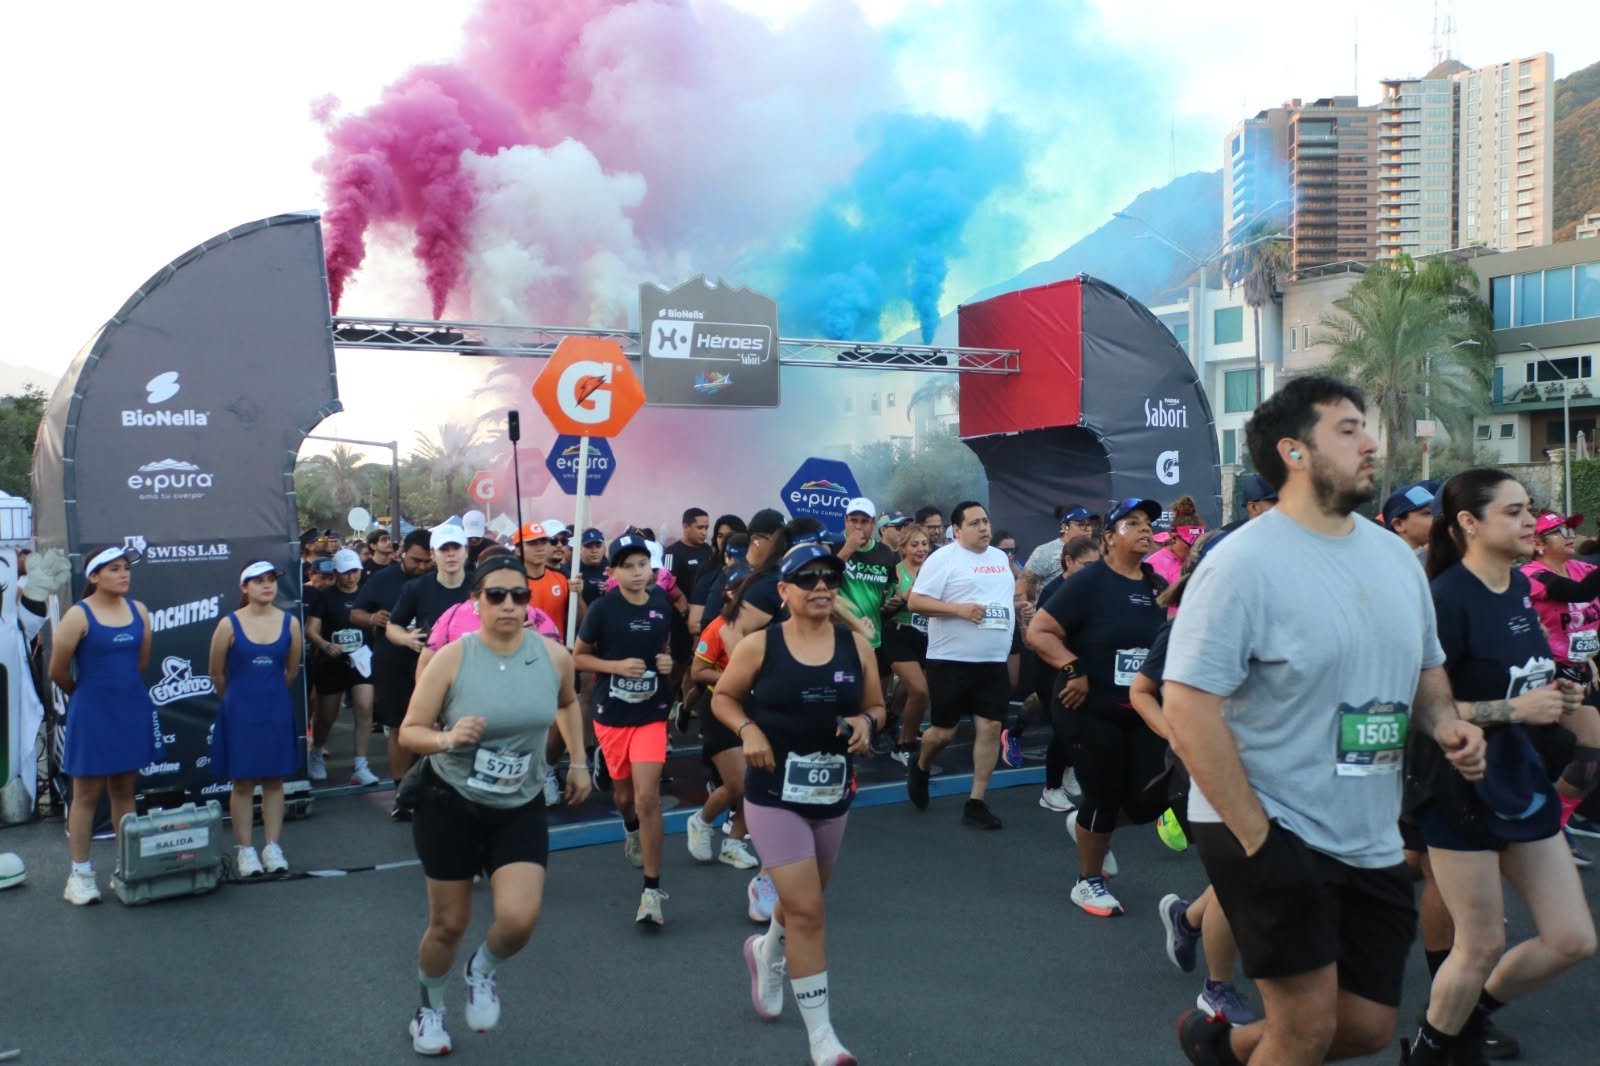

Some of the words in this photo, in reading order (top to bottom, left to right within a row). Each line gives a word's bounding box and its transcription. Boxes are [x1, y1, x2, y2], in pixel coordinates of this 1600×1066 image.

[668, 309, 704, 319] BioNella
[557, 360, 613, 424] G
[121, 409, 209, 427] BioNella
[1144, 397, 1187, 428] Sabori
[1156, 450, 1180, 485] G
[986, 608, 1006, 618] 5531
[617, 678, 650, 691] 6968
[1356, 722, 1400, 745] 1503
[487, 758, 523, 775] 5712
[807, 768, 830, 784] 60
[154, 836, 194, 850] SALIDA
[796, 987, 827, 999] RUN
